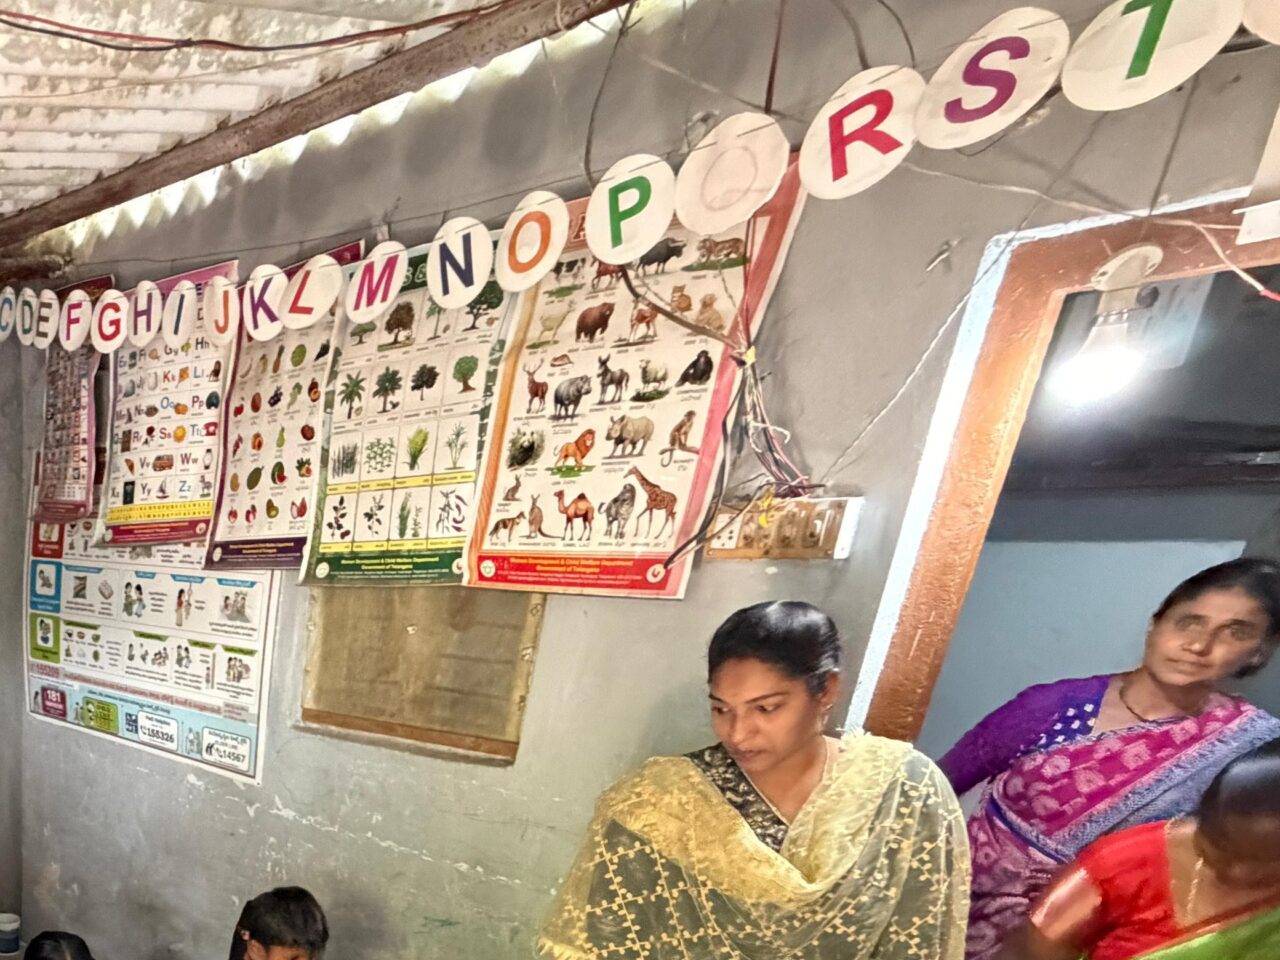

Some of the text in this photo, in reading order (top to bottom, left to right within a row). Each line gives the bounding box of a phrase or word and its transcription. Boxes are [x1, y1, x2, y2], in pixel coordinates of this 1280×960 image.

[21, 299, 33, 334] D
[35, 301, 53, 338] E
[66, 302, 83, 341] F
[98, 302, 121, 341] G
[132, 299, 153, 335] H
[173, 294, 185, 335] I
[214, 289, 230, 333] J
[250, 277, 280, 330] K
[288, 269, 315, 315] L
[353, 254, 399, 311] M
[439, 231, 475, 296] N
[508, 211, 552, 274] O
[608, 174, 653, 248] P
[826, 88, 904, 182] R
[943, 36, 1031, 124] S
